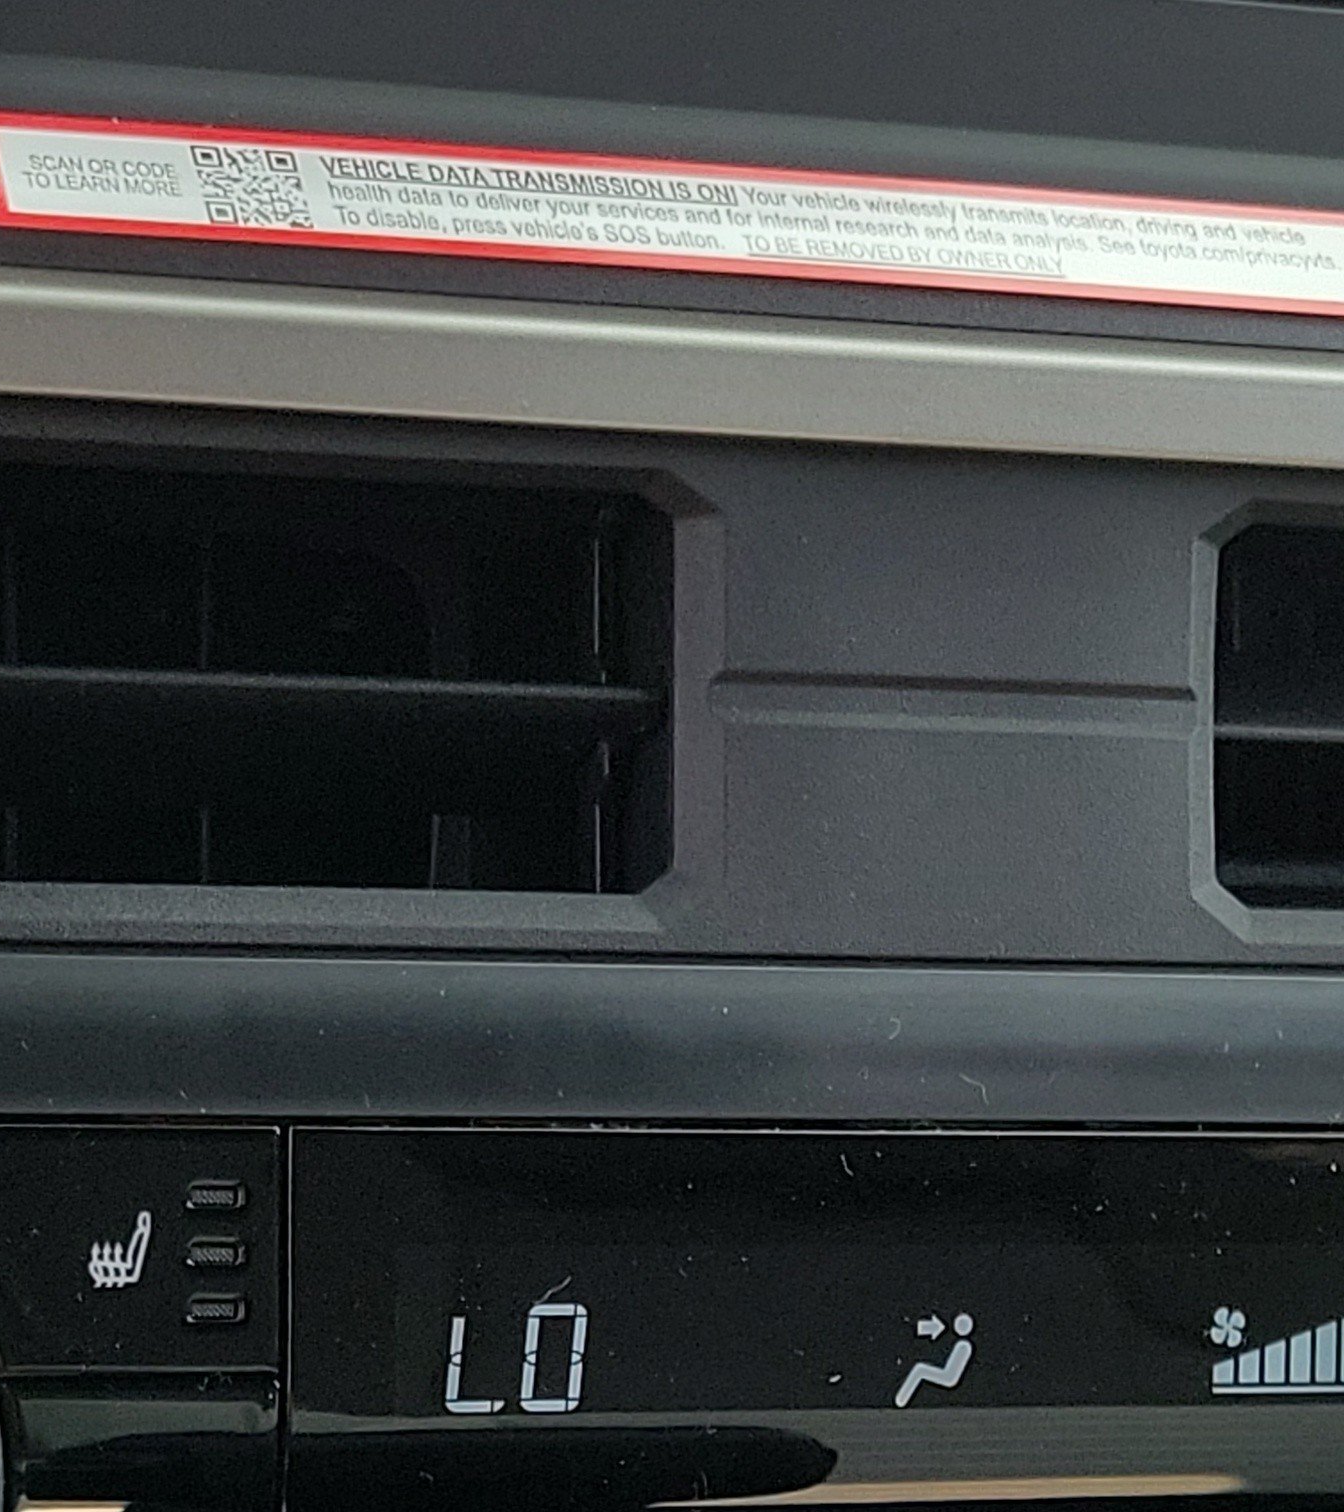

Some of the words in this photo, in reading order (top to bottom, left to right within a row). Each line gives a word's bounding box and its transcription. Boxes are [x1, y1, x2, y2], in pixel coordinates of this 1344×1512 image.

[22, 171, 50, 188] TO
[55, 174, 120, 193] LEARN
[123, 178, 183, 197] MORE
[29, 154, 84, 173] SCAN
[122, 161, 178, 179] CODE
[319, 156, 427, 181] VEHICLE
[428, 164, 489, 187] DATA
[491, 168, 666, 200] TRANSMISSION
[668, 181, 692, 200] IS
[740, 186, 786, 206] Your
[792, 191, 860, 212] vehicle
[864, 197, 957, 223] wirelessly
[961, 202, 1047, 226] transmits
[1053, 209, 1132, 236] location,
[1136, 216, 1198, 242] driving
[1203, 223, 1237, 241] and
[1242, 226, 1306, 246] vehicle
[328, 181, 390, 201] health
[398, 183, 443, 206] data
[448, 190, 468, 208] to
[476, 192, 540, 213] deliver
[545, 200, 589, 219] your
[597, 201, 678, 222] services
[685, 206, 721, 225] and
[726, 209, 752, 226] for
[757, 210, 830, 232] internal
[835, 219, 919, 241] research
[925, 225, 958, 242] and
[964, 227, 1006, 246] data
[1098, 235, 1136, 254] See
[334, 205, 360, 226] To
[366, 206, 447, 233] disable,
[452, 216, 507, 236] press
[510, 219, 598, 242] vehicle's
[603, 223, 651, 245] SOS
[657, 228, 726, 250] button.
[742, 234, 770, 253] TO
[775, 236, 803, 255] BE
[806, 238, 904, 262] REMOVED
[907, 245, 933, 264] BY
[938, 250, 1010, 269] OWNER
[1014, 253, 1064, 274] ONLY
